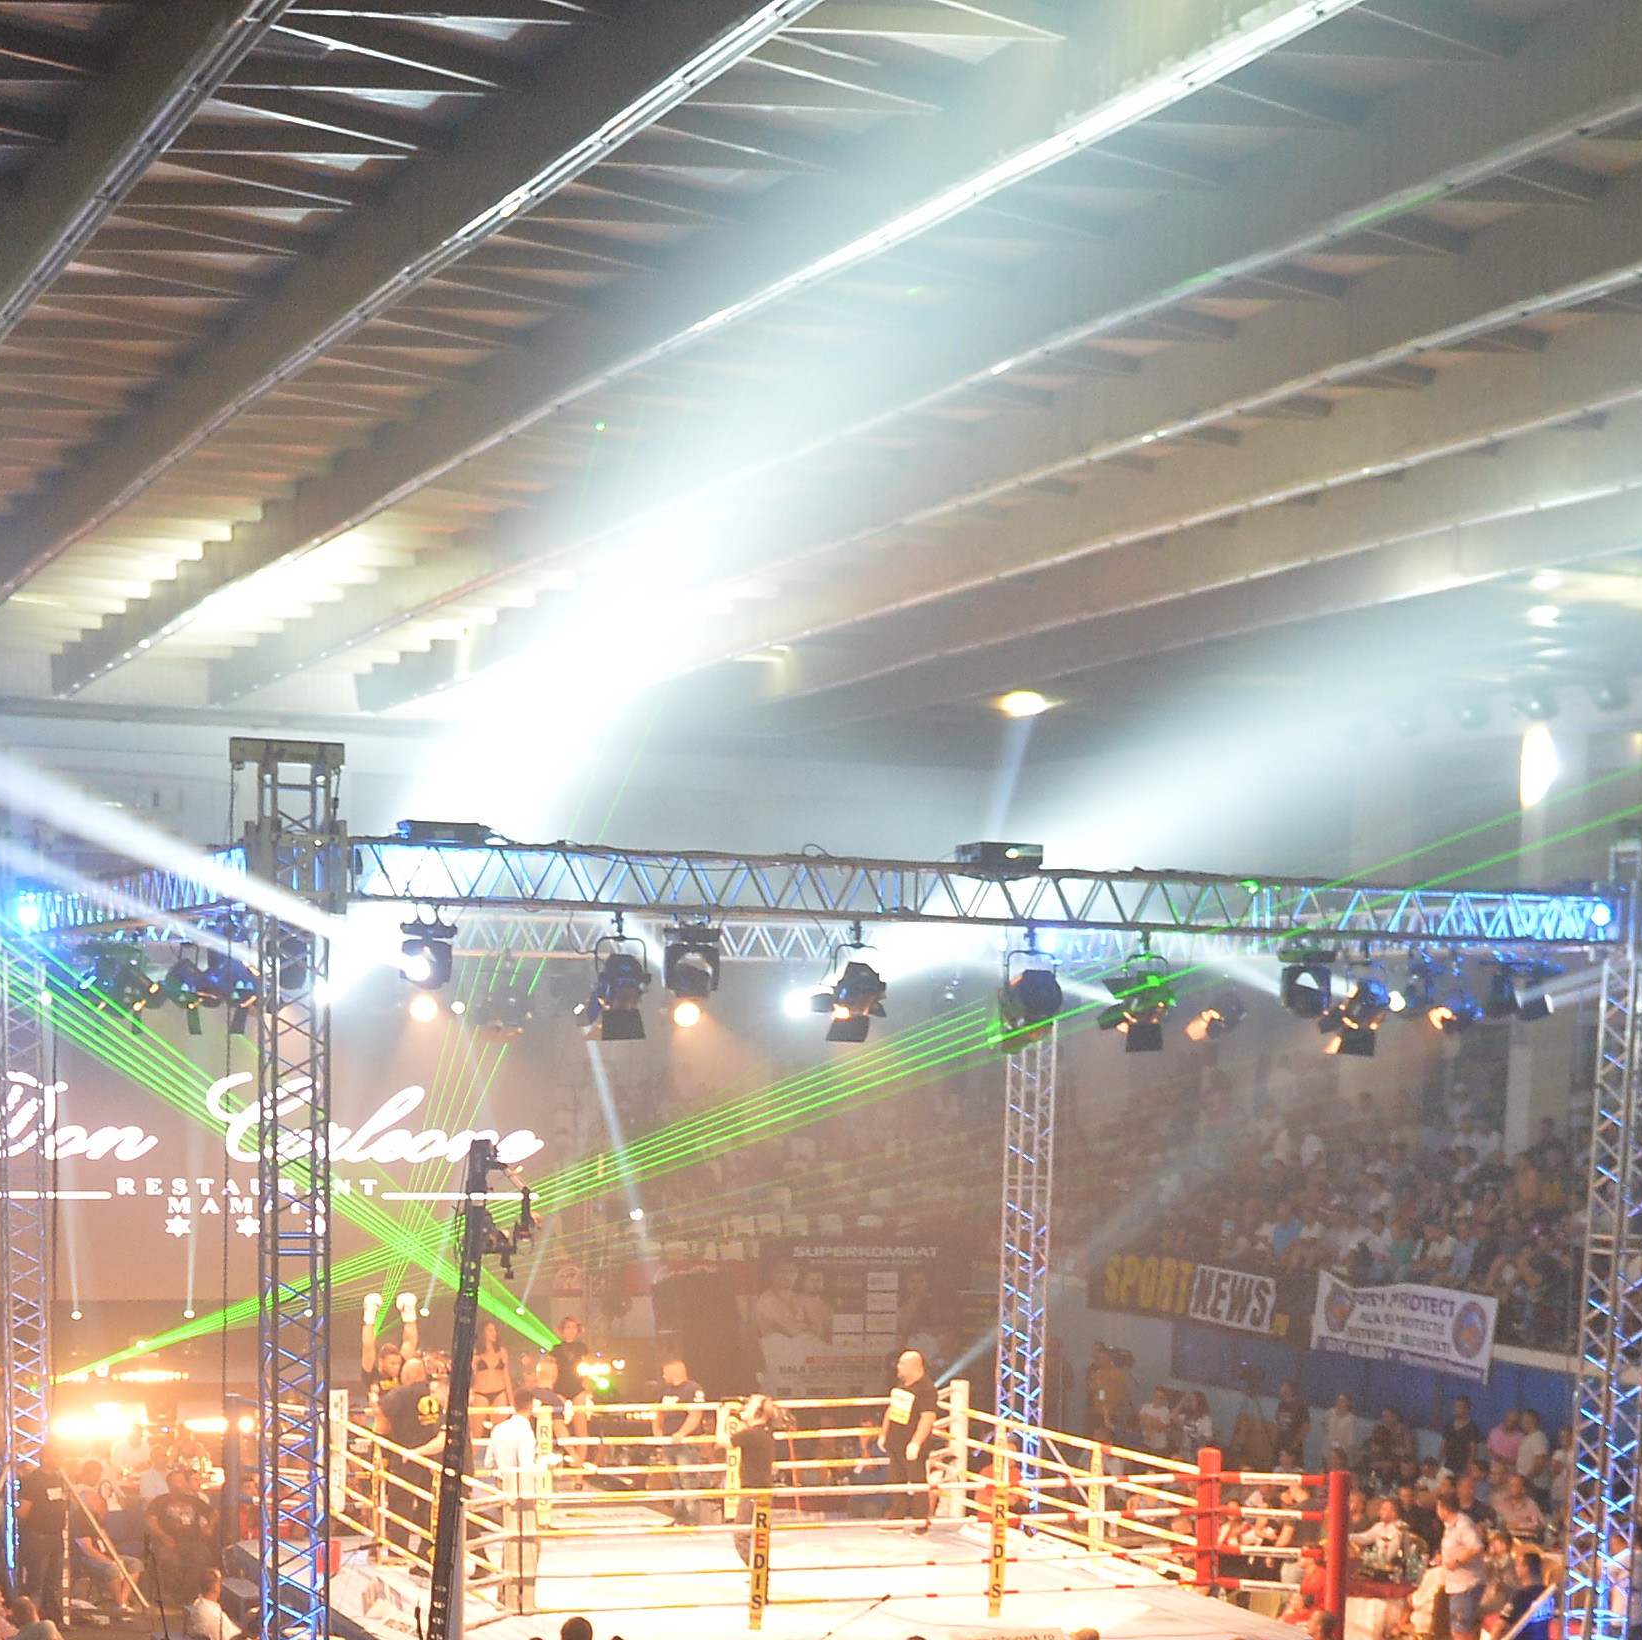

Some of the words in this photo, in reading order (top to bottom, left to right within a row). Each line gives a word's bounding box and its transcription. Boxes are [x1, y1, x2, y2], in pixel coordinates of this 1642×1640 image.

[116, 1177, 378, 1196] RESTAURNT
[792, 1246, 939, 1258] SUPERKOMBAT
[1103, 1254, 1195, 1315] SPORT
[1194, 1267, 1273, 1327] NEWS
[751, 1511, 768, 1611] REDIS
[991, 1503, 1006, 1599] REDIS
